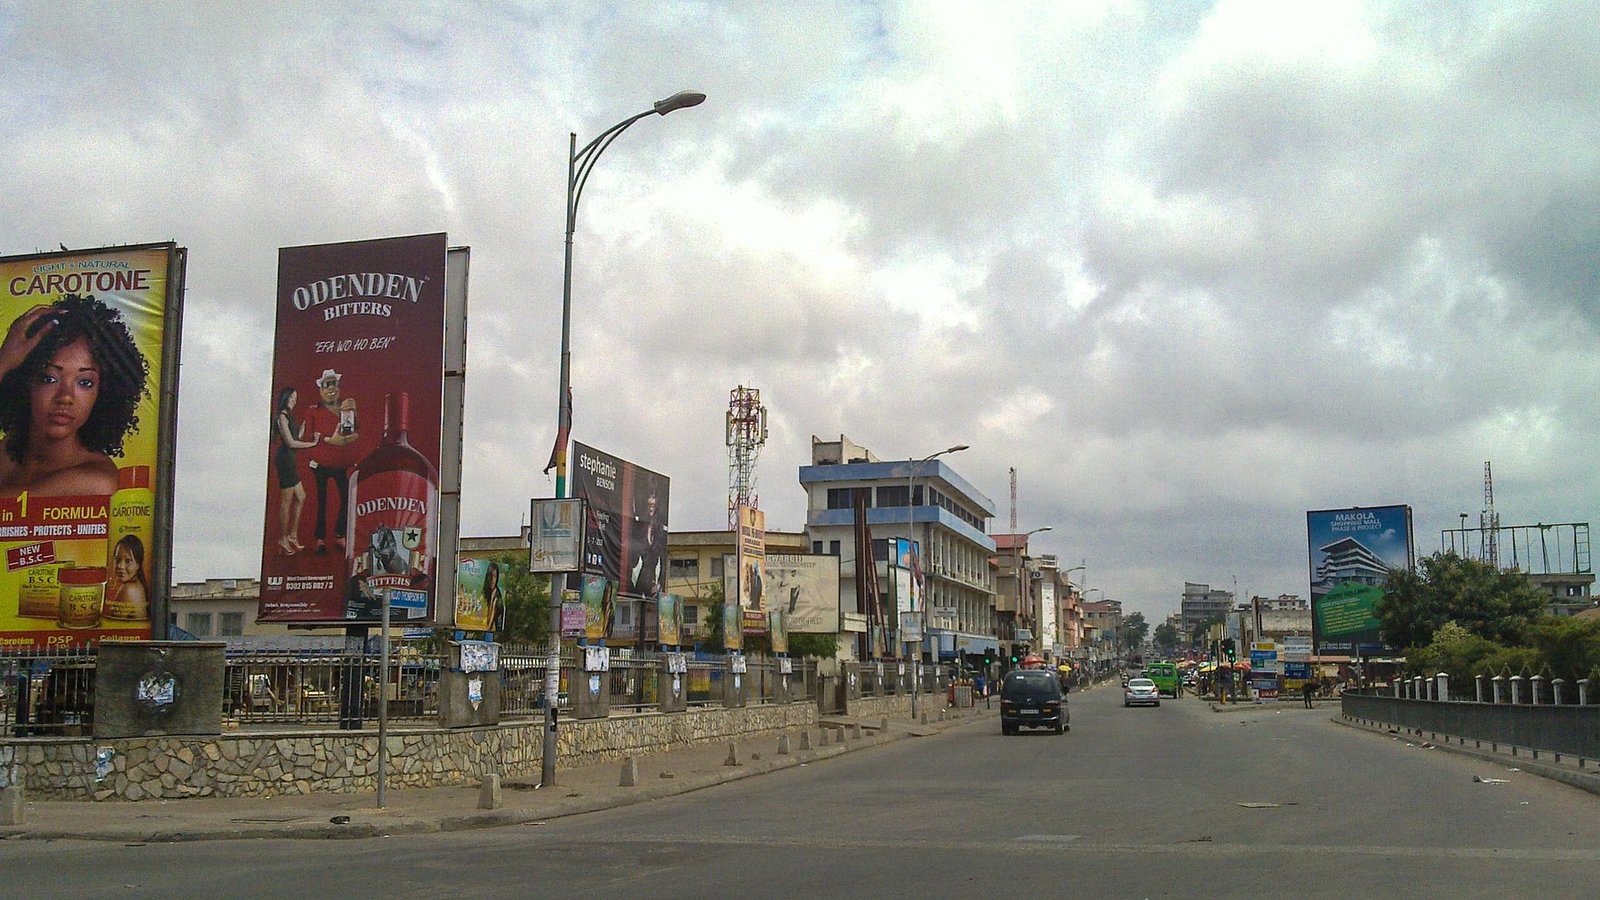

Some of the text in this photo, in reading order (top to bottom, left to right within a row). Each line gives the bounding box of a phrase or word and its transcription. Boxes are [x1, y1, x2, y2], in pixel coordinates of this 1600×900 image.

[32, 262, 66, 274] LIGHT
[78, 259, 131, 269] NATURAL
[9, 269, 152, 297] CAROTONE
[293, 272, 425, 311] ODENDEN
[324, 301, 392, 321] BITTERS
[580, 453, 617, 479] stephanie
[596, 476, 616, 491] BENSON
[2, 490, 108, 522] in 1 FORMULA
[112, 505, 151, 518] CAROTONE
[357, 496, 427, 516] ODENDEN
[1335, 512, 1375, 521] MAKOLA
[33, 524, 72, 537] PROTECTS
[77, 523, 107, 535] UNIFIES
[19, 544, 41, 556] NEW
[19, 554, 43, 567] B.S.C
[368, 577, 412, 588] BITTERS
[47, 635, 74, 644] DSP
